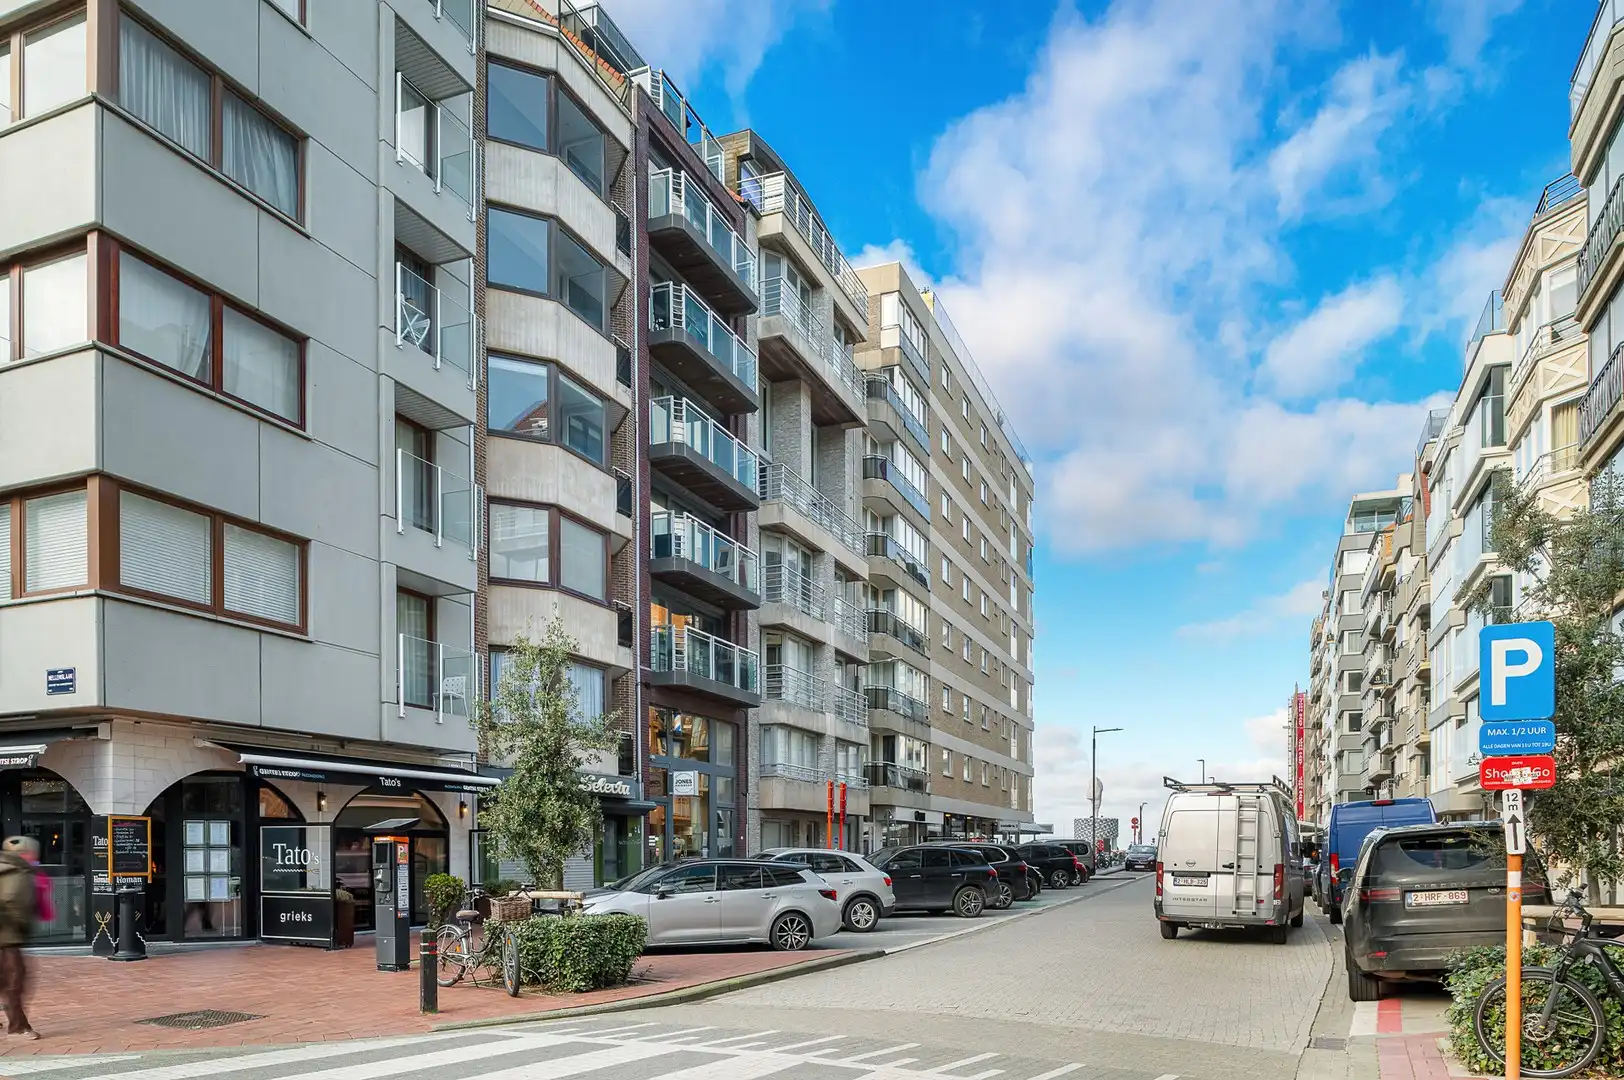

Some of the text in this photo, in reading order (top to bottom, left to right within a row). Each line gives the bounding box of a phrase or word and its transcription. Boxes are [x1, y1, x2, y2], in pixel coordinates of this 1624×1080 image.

[1491, 638, 1543, 706] P
[1487, 726, 1547, 736] MAX. 1/2 UUR
[379, 777, 401, 787] Tato's
[579, 775, 630, 796] Selecta
[1506, 792, 1519, 802] 12
[273, 843, 320, 865] Tato's
[116, 876, 142, 884] Roman
[280, 911, 313, 923] grieks
